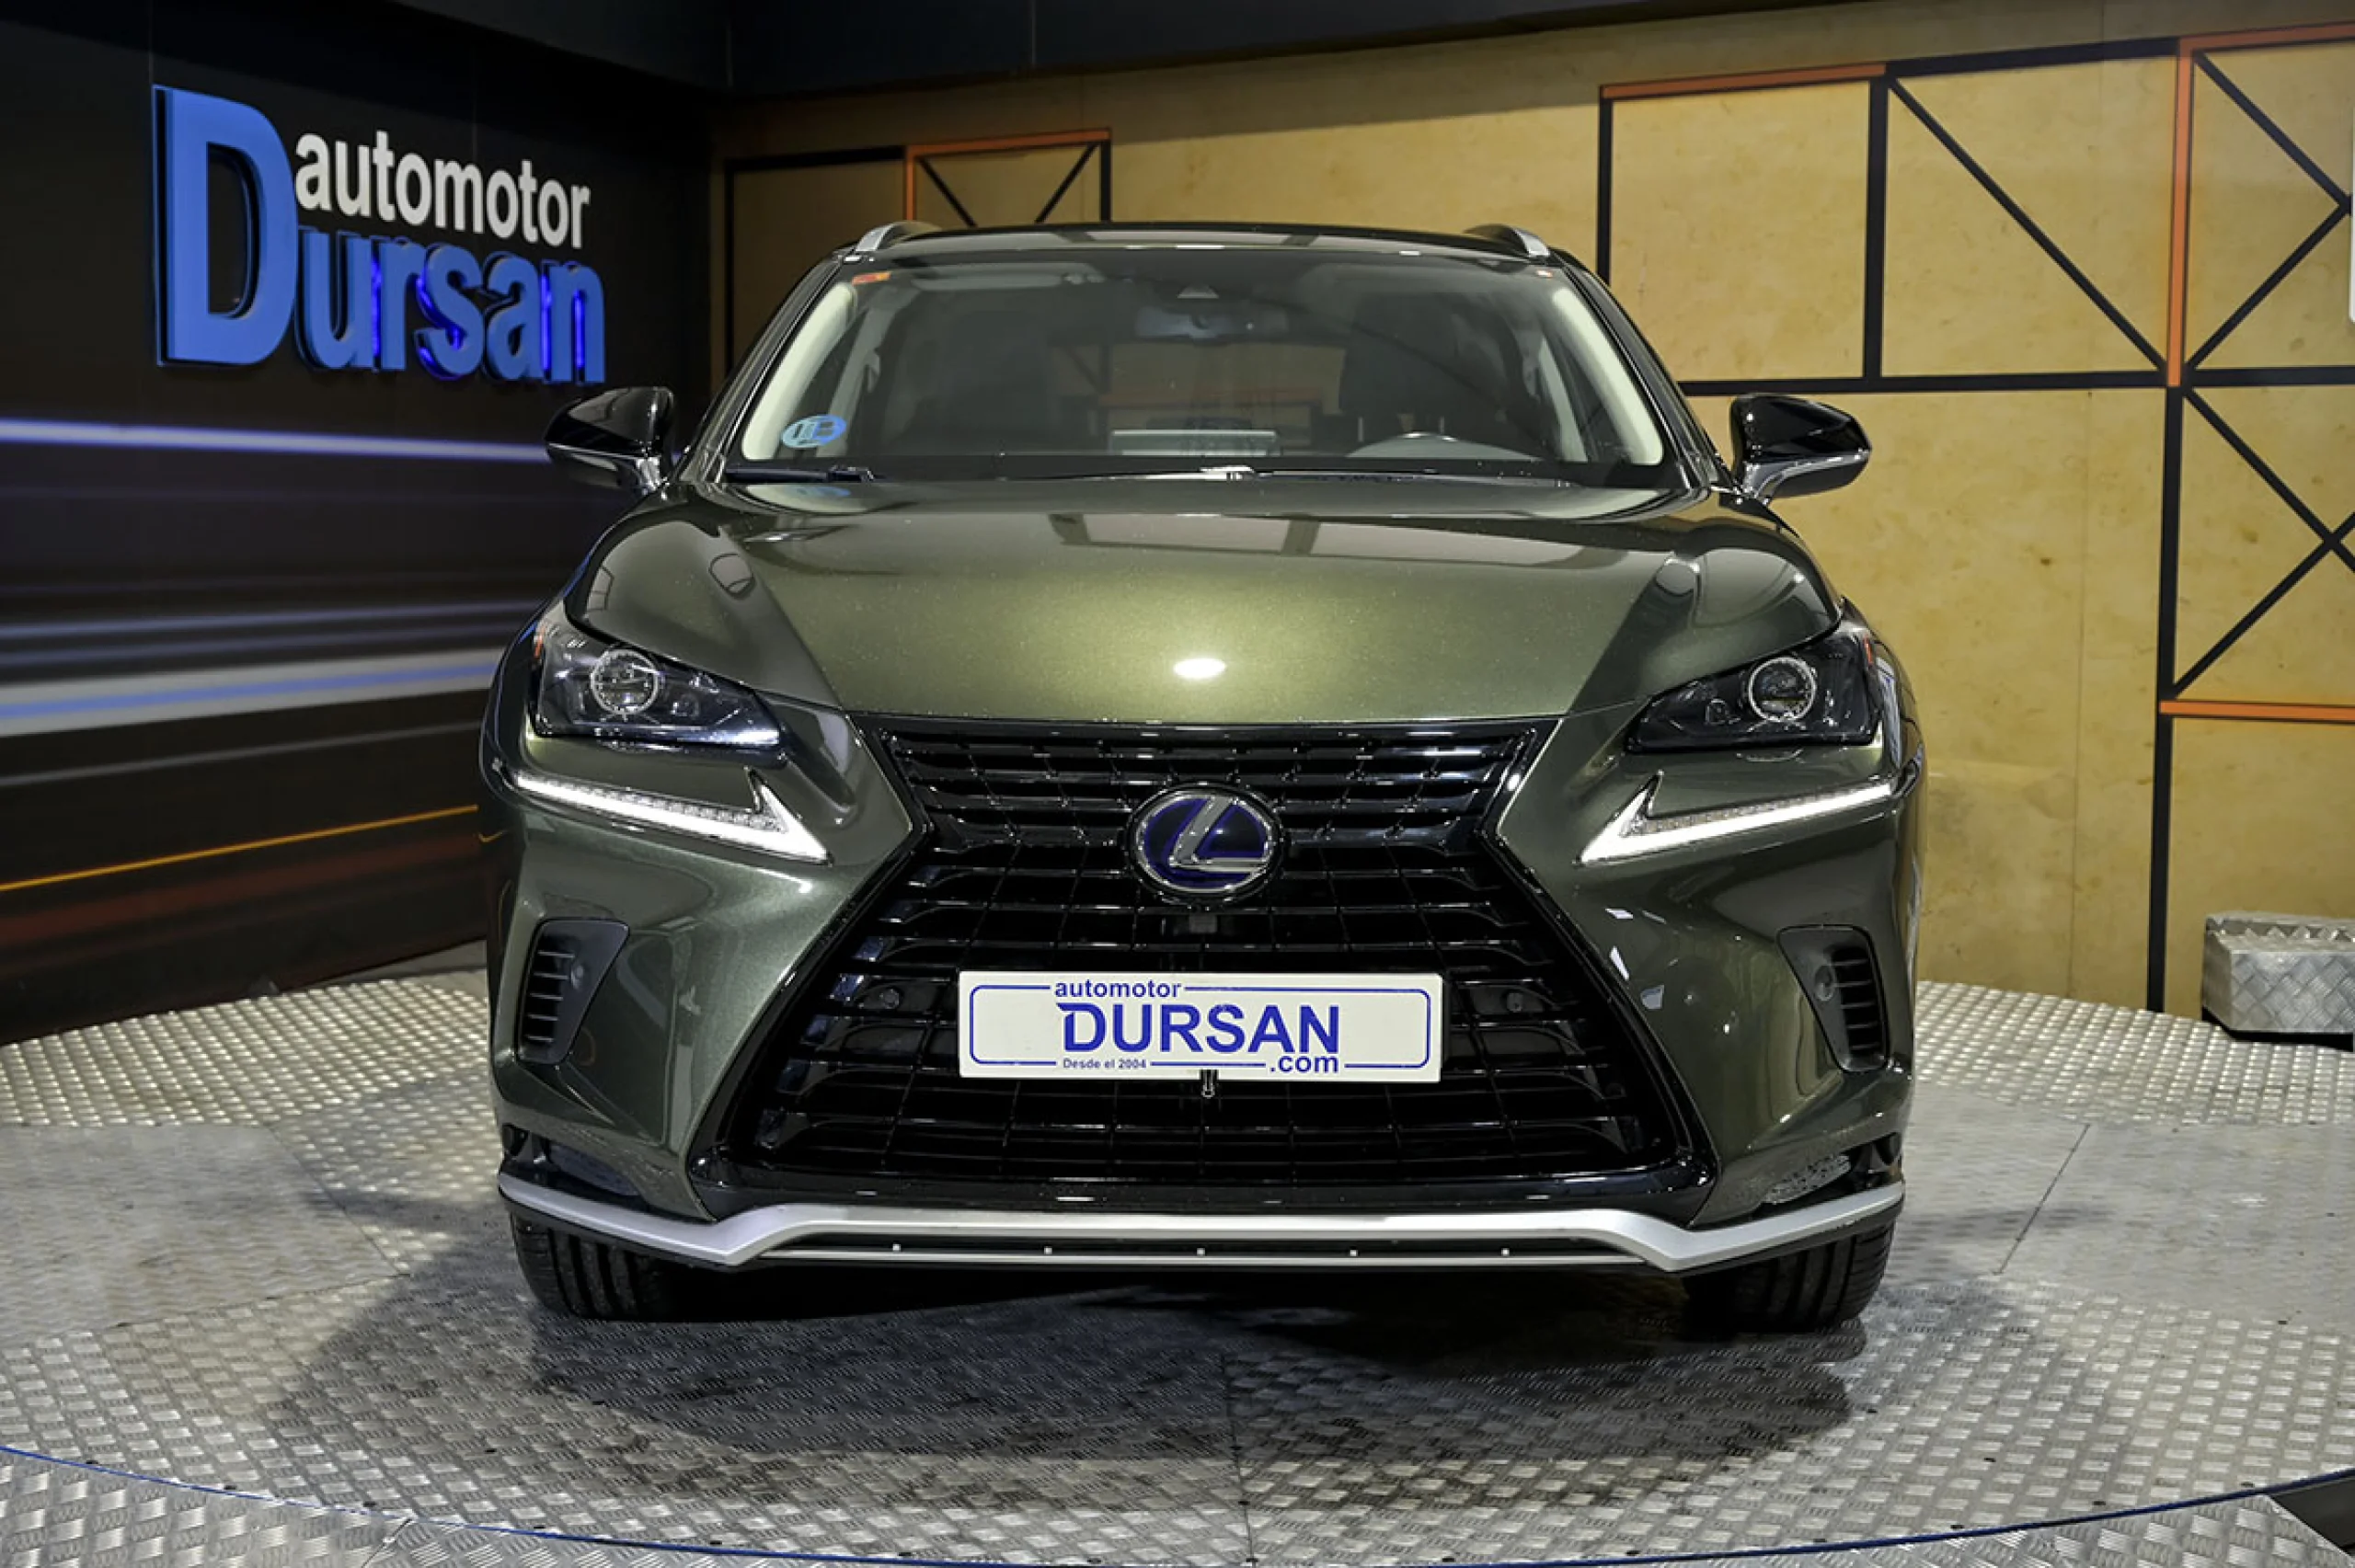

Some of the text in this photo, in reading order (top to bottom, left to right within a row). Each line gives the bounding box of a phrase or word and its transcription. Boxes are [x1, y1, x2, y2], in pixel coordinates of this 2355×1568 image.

[295, 131, 591, 248] automotor
[153, 84, 606, 384] Dursan
[1054, 979, 1181, 998] automotor
[1056, 1002, 1339, 1054] DURSAN
[1063, 1059, 1147, 1073] Desde el 2004
[1269, 1056, 1339, 1074] .com
